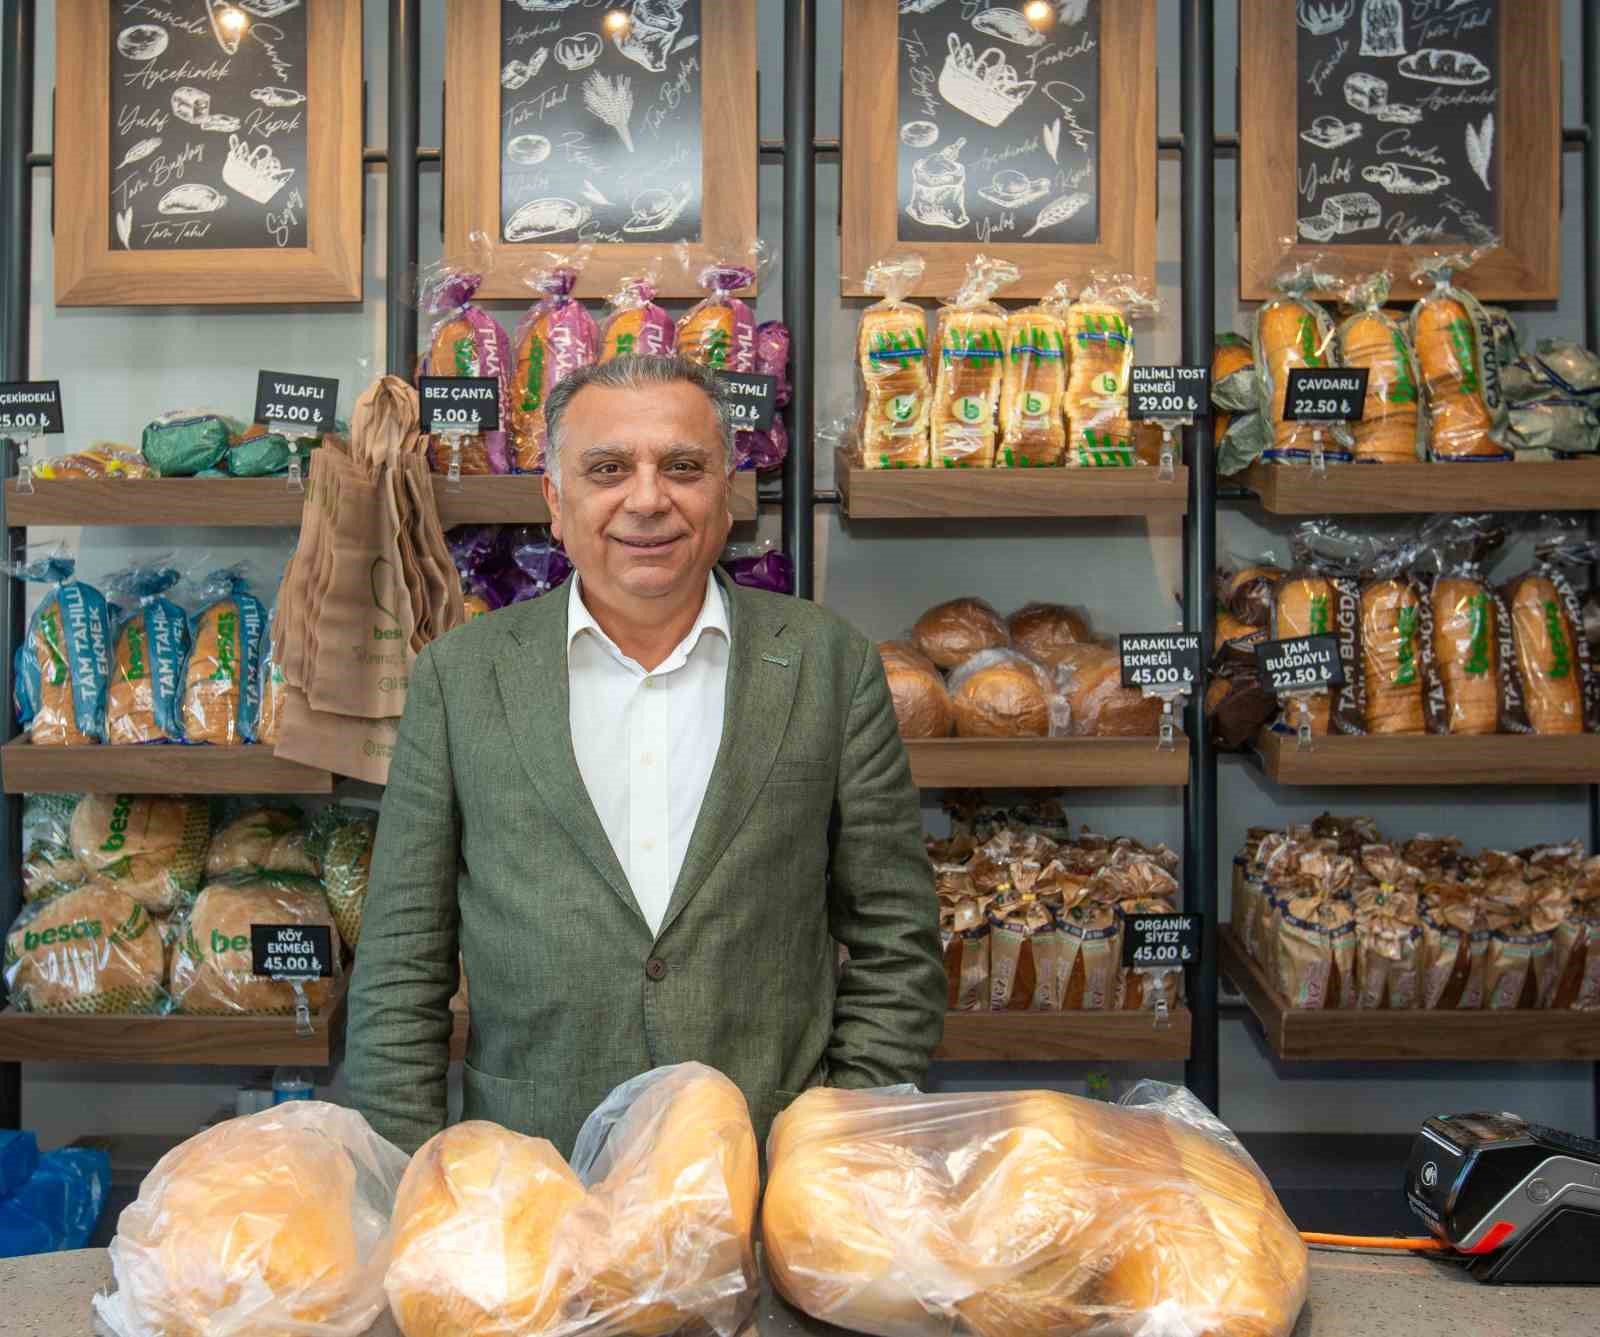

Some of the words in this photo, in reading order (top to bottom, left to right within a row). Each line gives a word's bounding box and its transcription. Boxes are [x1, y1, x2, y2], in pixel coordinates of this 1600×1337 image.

[1133, 367, 1175, 380] DİLİMLİ
[1176, 369, 1207, 380] TOST
[273, 382, 325, 400] YULAFLI
[728, 382, 768, 398] EYMLİ
[1133, 380, 1176, 394] EKMEĞİ
[1297, 378, 1360, 392] ÇAVDARLI
[424, 387, 449, 399] BEZ
[450, 387, 494, 401] ÇANTA
[1138, 396, 1184, 411] 29.00
[1294, 400, 1337, 414] 22.50
[265, 403, 310, 421] 25.00
[432, 408, 468, 422] 5.00
[0, 413, 37, 428] 5.00
[89, 606, 111, 677] EKMEK
[1123, 637, 1199, 651] KARAKILÇIK
[1280, 640, 1310, 656] TAM
[1123, 651, 1172, 667] EKMEĞİ
[1266, 650, 1330, 671] BUĞDAYLI
[77, 655, 98, 701] TAM
[156, 651, 176, 699] TAM
[1131, 667, 1179, 684] 45.00
[1272, 667, 1317, 688] 22.50
[1134, 915, 1192, 931] ORGANİK
[277, 928, 303, 942] KÖY
[1144, 929, 1180, 943] SİYEZ
[267, 941, 315, 954] EKMEĞİ
[1134, 946, 1178, 960] 45.00
[263, 956, 308, 971] 45.00
